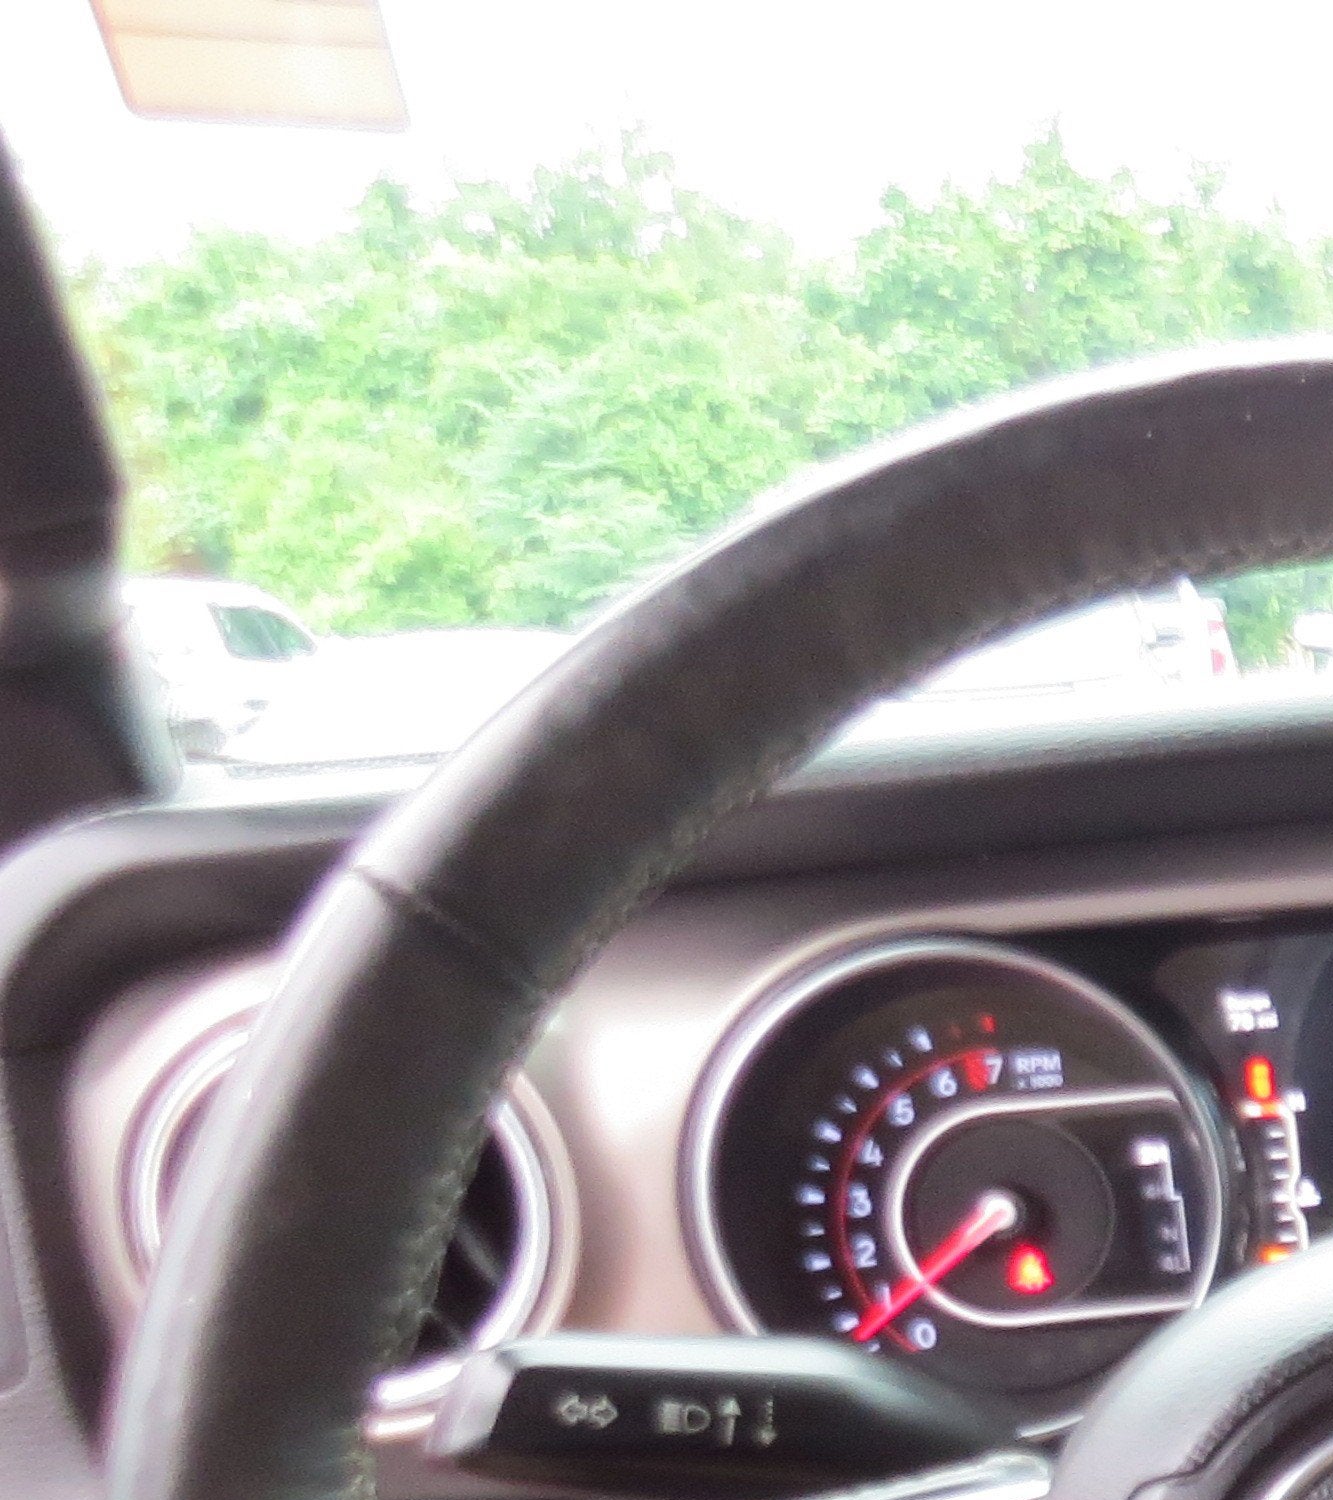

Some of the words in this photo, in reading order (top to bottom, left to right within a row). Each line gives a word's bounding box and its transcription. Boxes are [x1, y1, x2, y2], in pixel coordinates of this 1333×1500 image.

[1014, 1050, 1061, 1073] RPM
[932, 1069, 958, 1097] 6
[890, 1097, 915, 1126] 5
[860, 1139, 884, 1168] 4
[848, 1186, 873, 1218] 3
[853, 1238, 877, 1268] 2
[907, 1318, 938, 1349] 0
